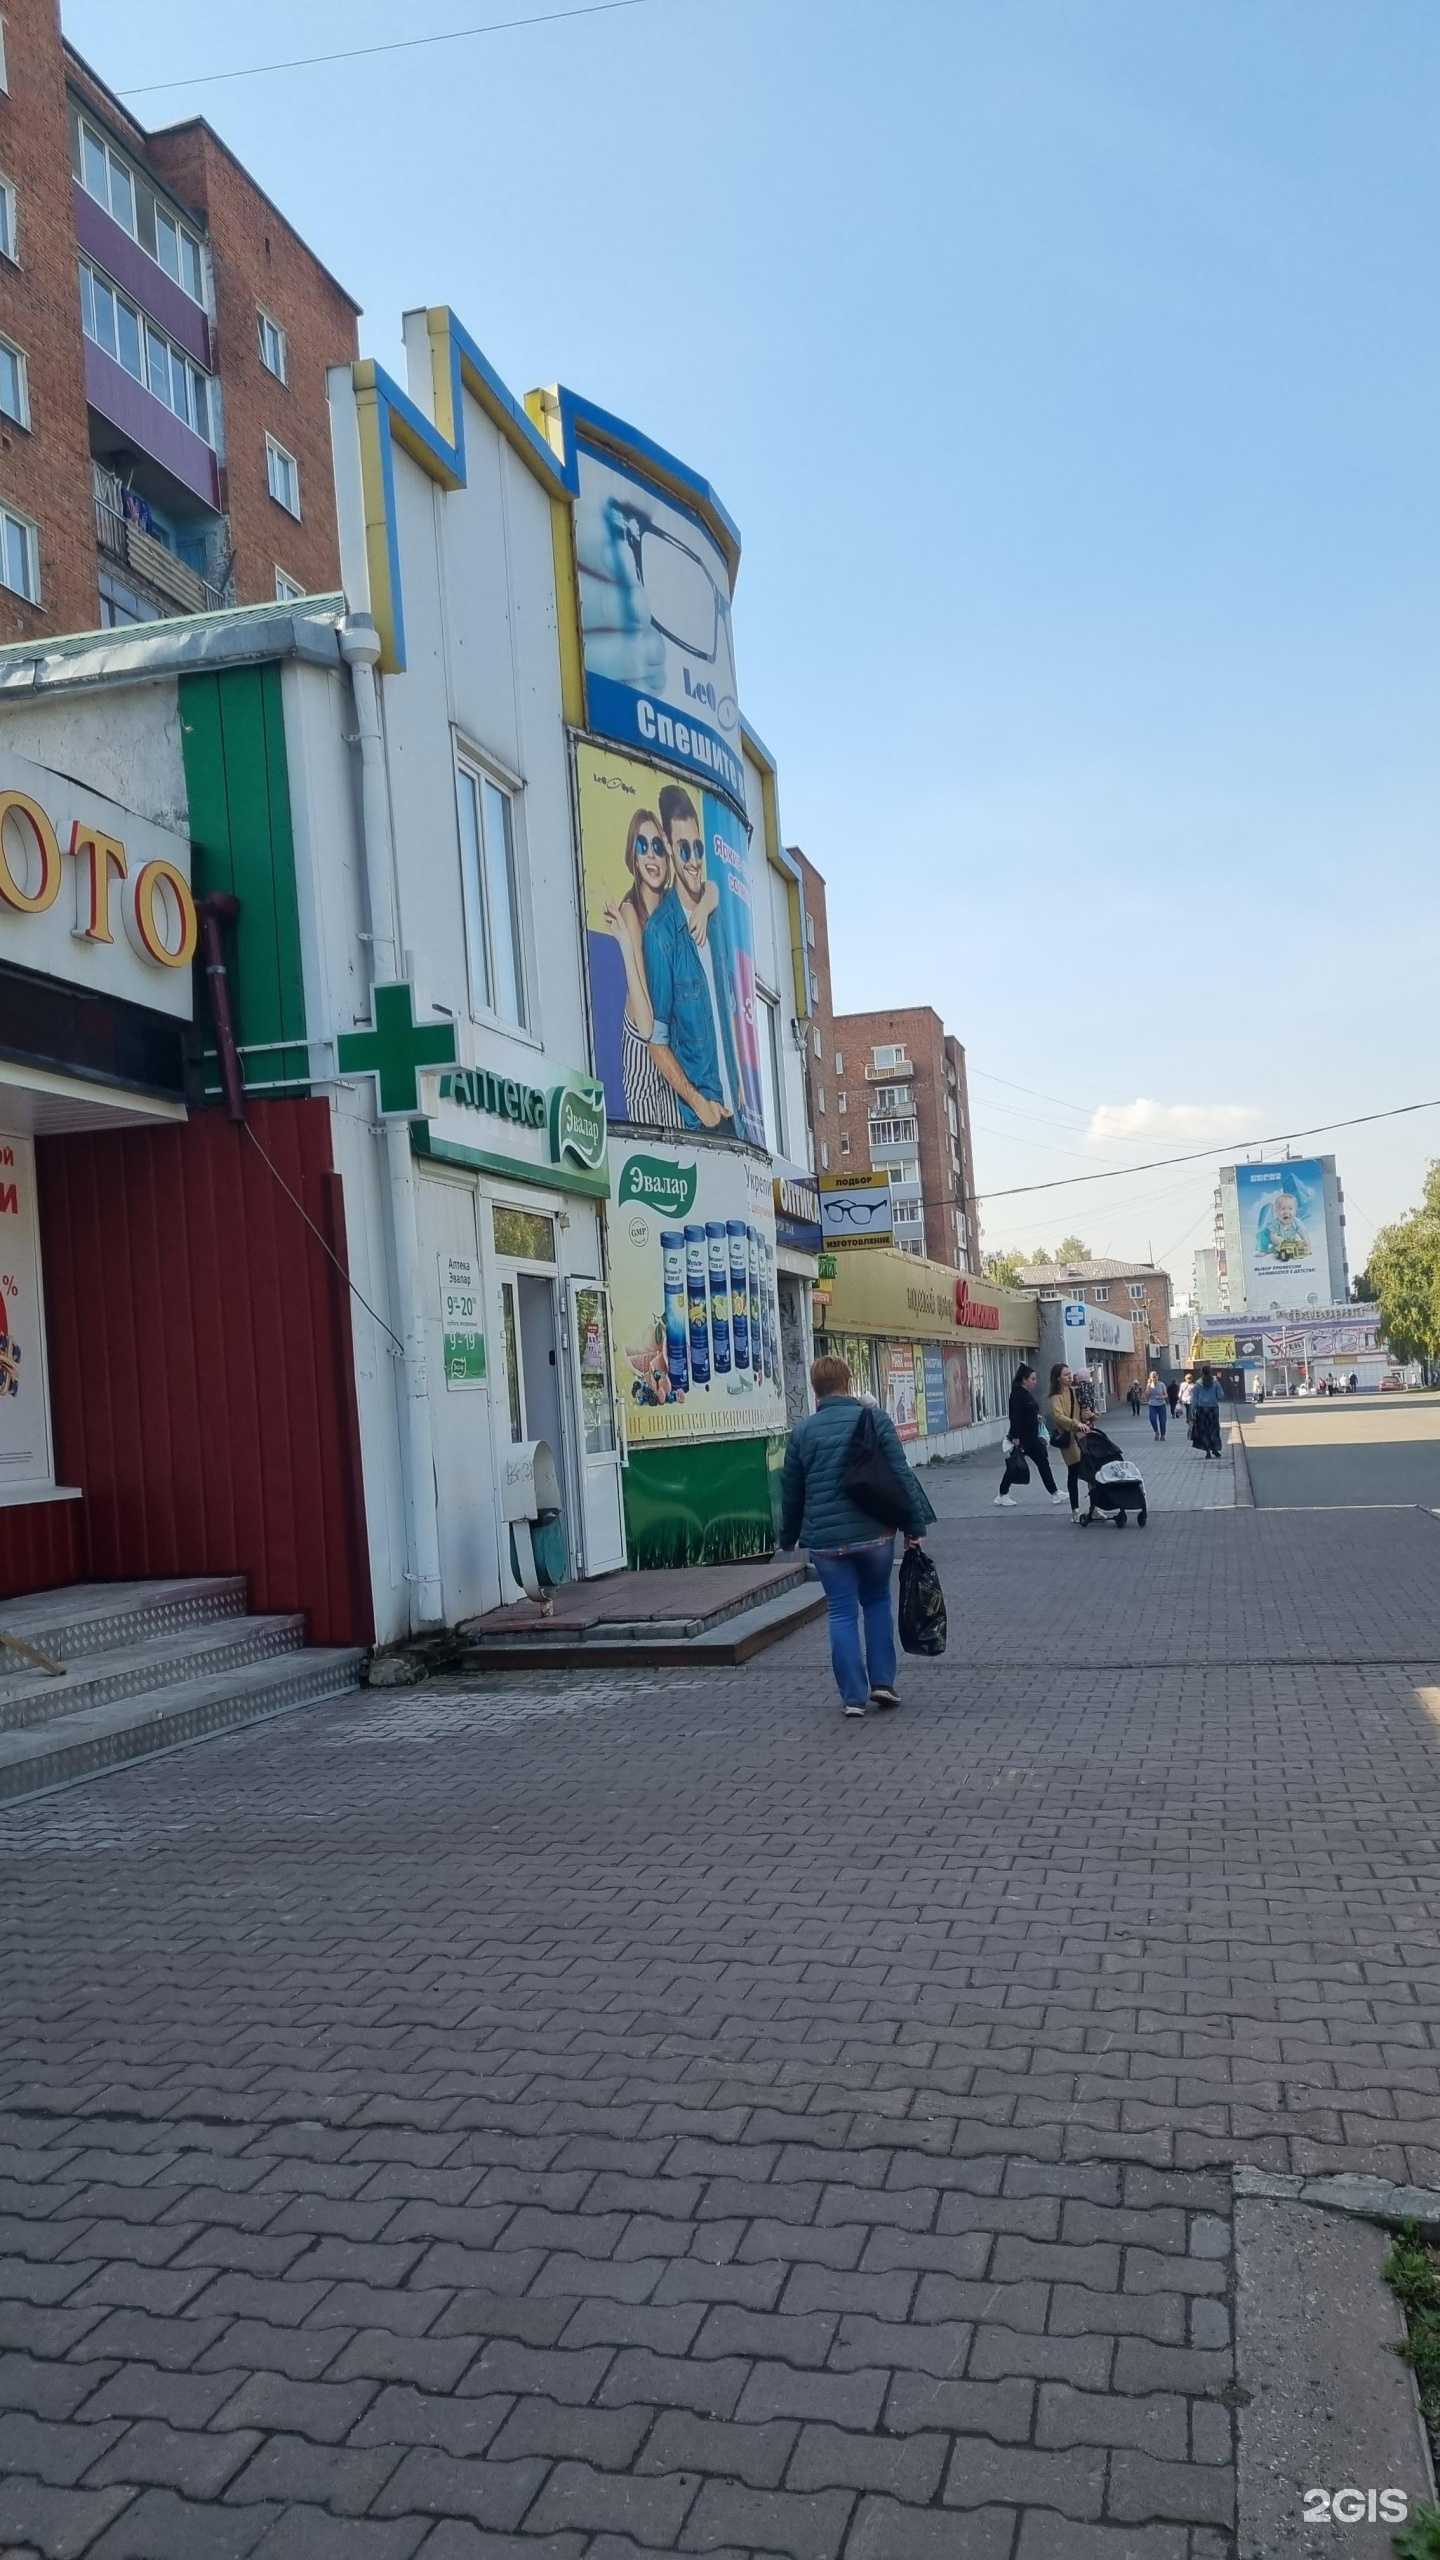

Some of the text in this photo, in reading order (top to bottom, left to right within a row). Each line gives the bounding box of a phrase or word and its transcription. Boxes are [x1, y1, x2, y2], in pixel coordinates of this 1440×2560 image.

[565, 1104, 599, 1146] Эвалар
[629, 1166, 688, 1202] Эвалар
[835, 1176, 873, 1187] ПОДБОР
[826, 1236, 890, 1249] ИЗГОТОВЛЕНИЕ
